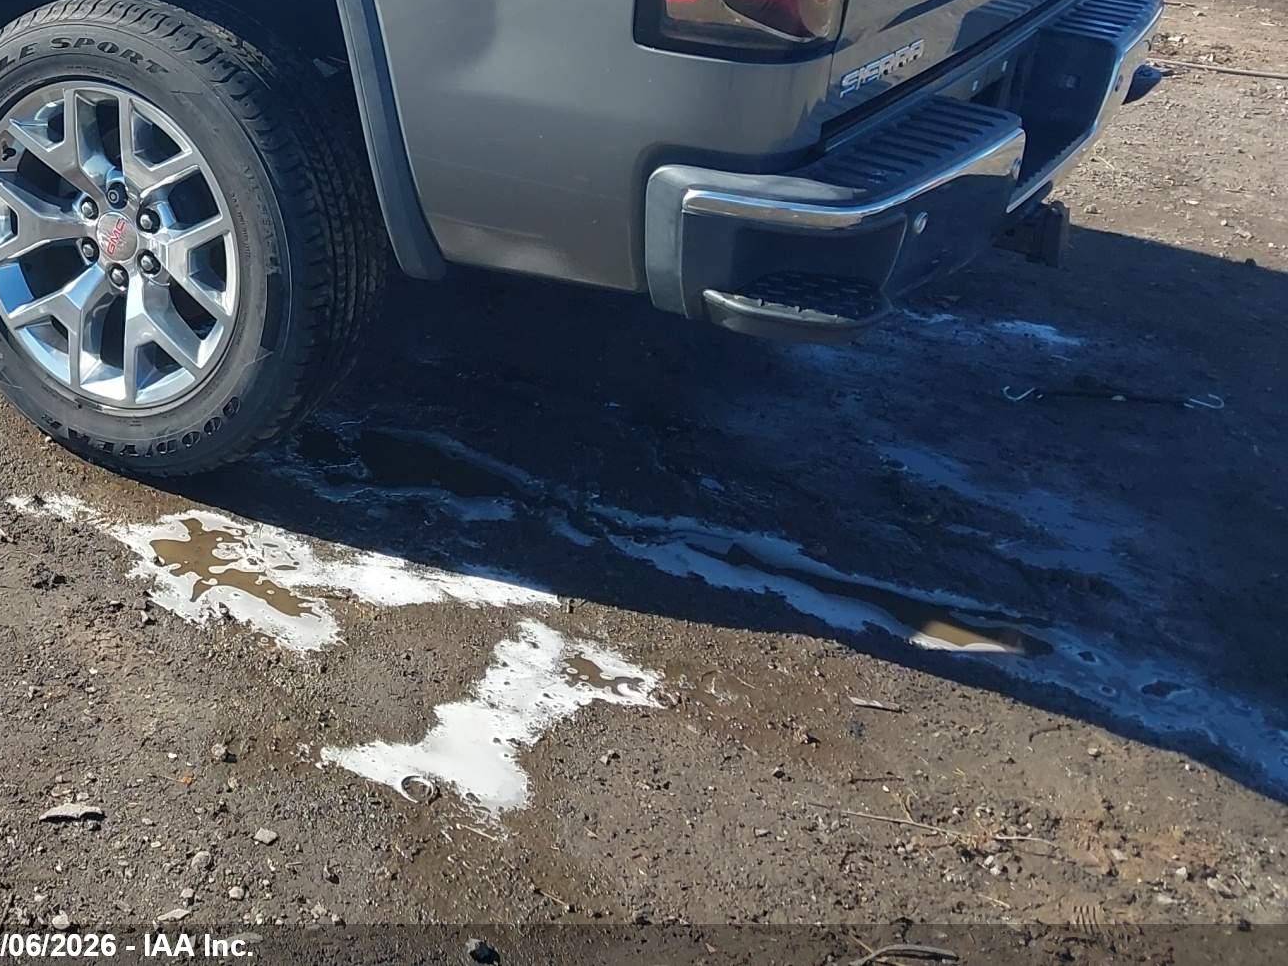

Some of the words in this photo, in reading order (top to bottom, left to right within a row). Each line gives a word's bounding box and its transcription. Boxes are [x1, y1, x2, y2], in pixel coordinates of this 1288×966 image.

[49, 36, 170, 75] SPORT
[839, 38, 925, 99] SIERRA
[106, 217, 126, 256] GMC
